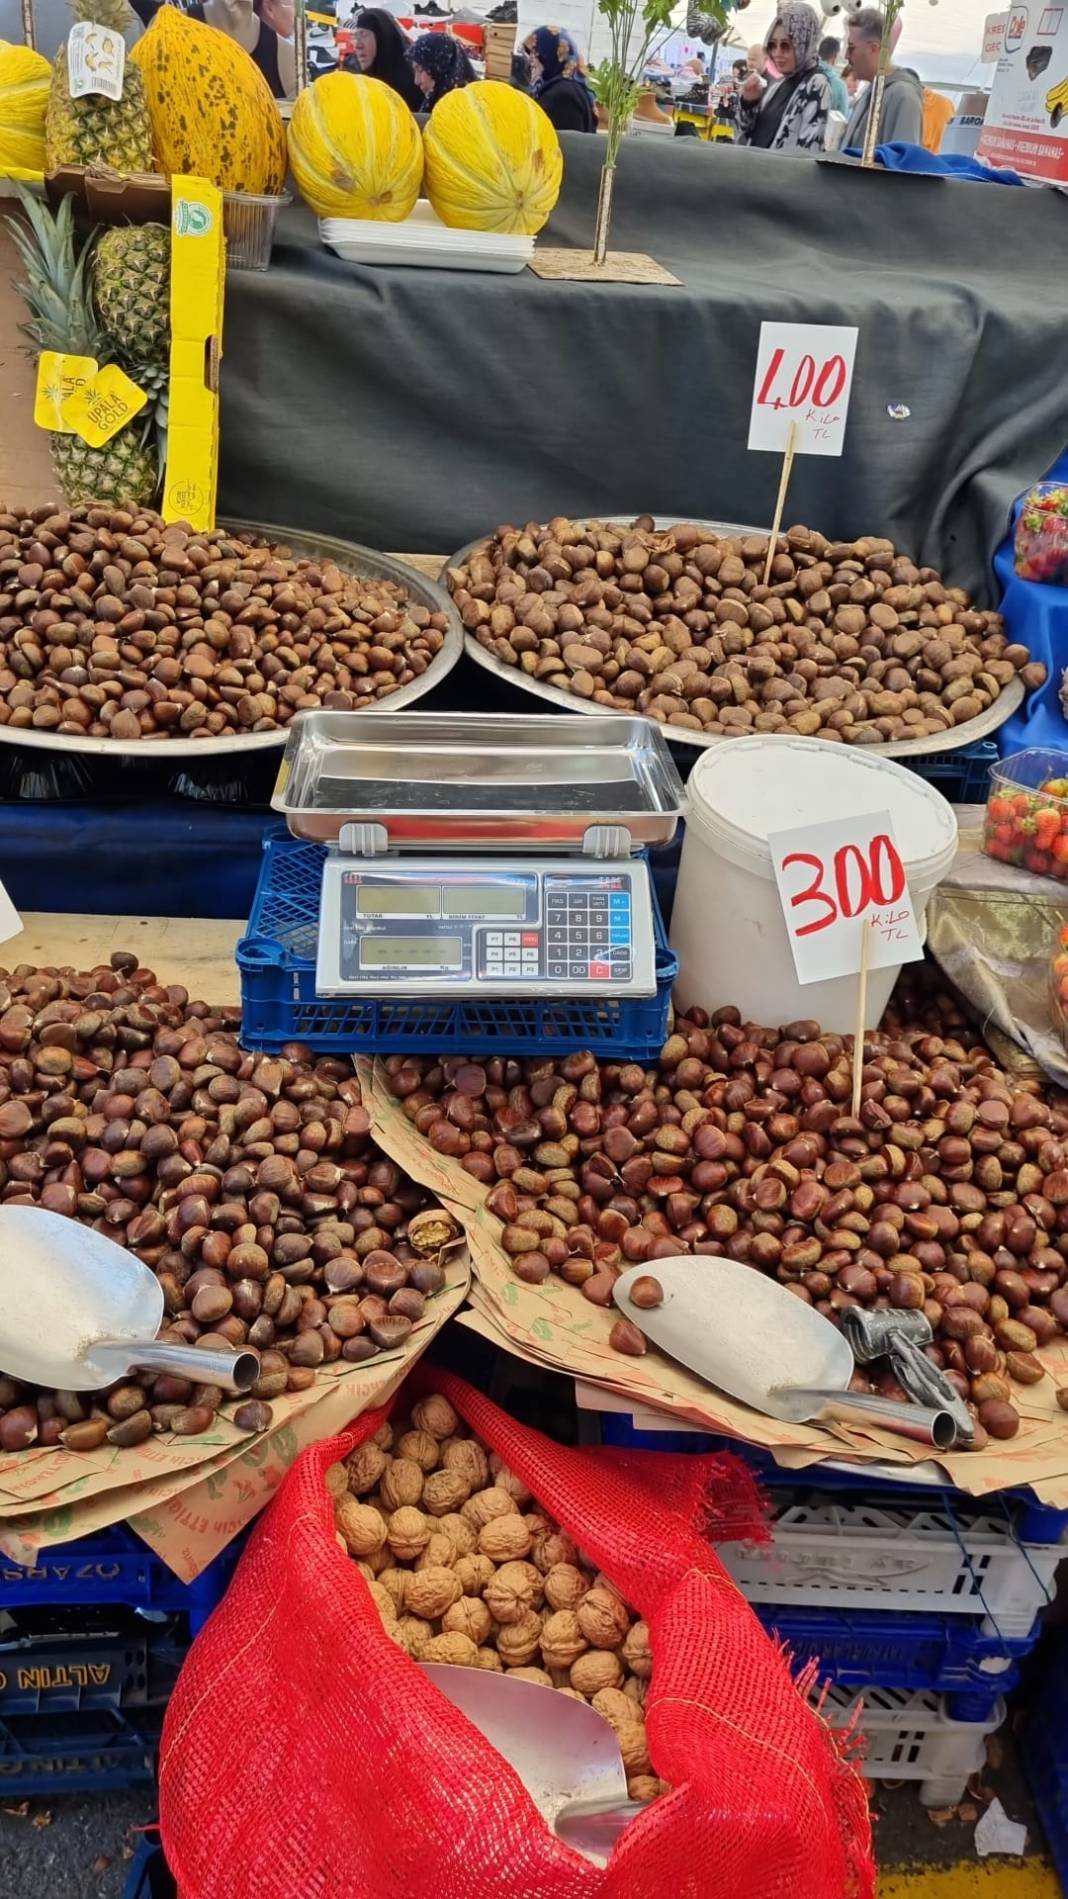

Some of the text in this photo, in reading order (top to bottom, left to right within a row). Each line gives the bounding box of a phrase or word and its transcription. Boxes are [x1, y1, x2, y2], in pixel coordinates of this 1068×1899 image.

[757, 348, 846, 411] 400
[88, 394, 121, 424] UPALA
[98, 402, 129, 431] GOLD
[812, 428, 831, 439] TL
[782, 834, 905, 937] 300
[554, 914, 561, 922] 7
[575, 914, 582, 922] 8
[596, 914, 602, 922] 9
[554, 931, 561, 939] 4
[575, 931, 582, 939] 5
[596, 931, 602, 939] 6
[880, 928, 909, 941] TL
[556, 949, 561, 957] 1
[575, 949, 583, 957] 2
[554, 966, 562, 974] 0
[572, 966, 586, 974] 00
[596, 966, 603, 975] C
[17, 1663, 111, 1689] ALTIN
